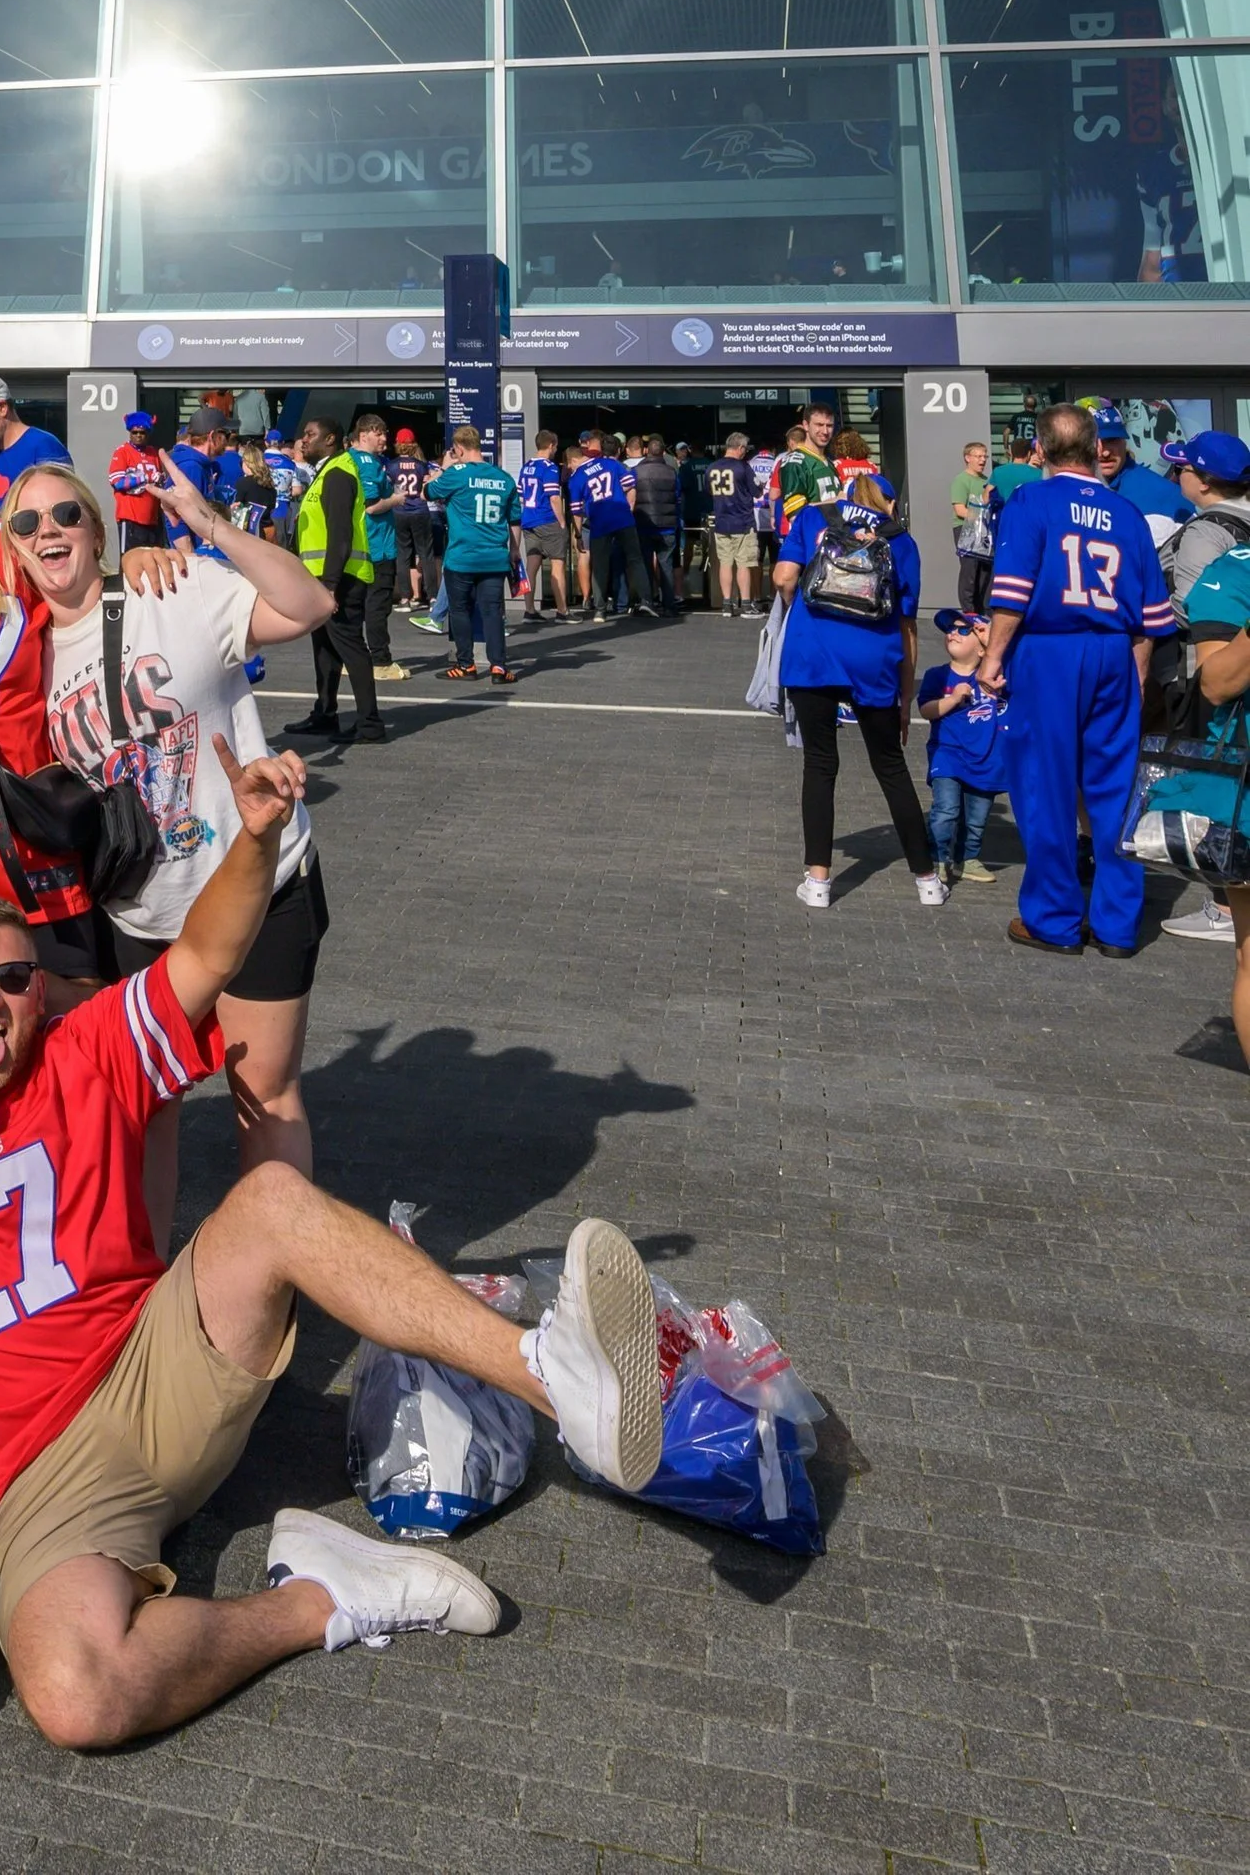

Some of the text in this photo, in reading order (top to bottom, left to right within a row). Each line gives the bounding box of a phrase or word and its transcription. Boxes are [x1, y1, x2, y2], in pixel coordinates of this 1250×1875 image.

[1069, 12, 1121, 143] BLLS
[557, 329, 580, 337] above
[723, 323, 737, 331] You
[754, 323, 770, 331] also
[772, 323, 795, 331] select
[797, 323, 820, 331] 'Show
[822, 323, 842, 331] code'
[723, 334, 754, 342] Android
[766, 334, 790, 342] select
[792, 334, 804, 342] the
[842, 334, 869, 342] iPhone
[871, 334, 886, 342] and
[180, 337, 202, 345] Please
[204, 337, 220, 345] have
[239, 337, 261, 346] digital
[263, 337, 282, 345] ticket
[284, 337, 304, 345] ready
[515, 340, 543, 348] located
[556, 341, 569, 349] top
[782, 345, 794, 353] QR
[81, 384, 118, 412] 20
[409, 391, 435, 400] South
[503, 384, 523, 412] 0
[724, 390, 752, 399] South
[923, 383, 967, 413] 20
[469, 477, 506, 491] LAWRENCE
[587, 471, 613, 503] 27
[710, 469, 735, 496] 23
[474, 493, 502, 524] 16
[1070, 502, 1112, 532] DAVIS
[1061, 533, 1121, 611] 13
[168, 719, 195, 748] AFC
